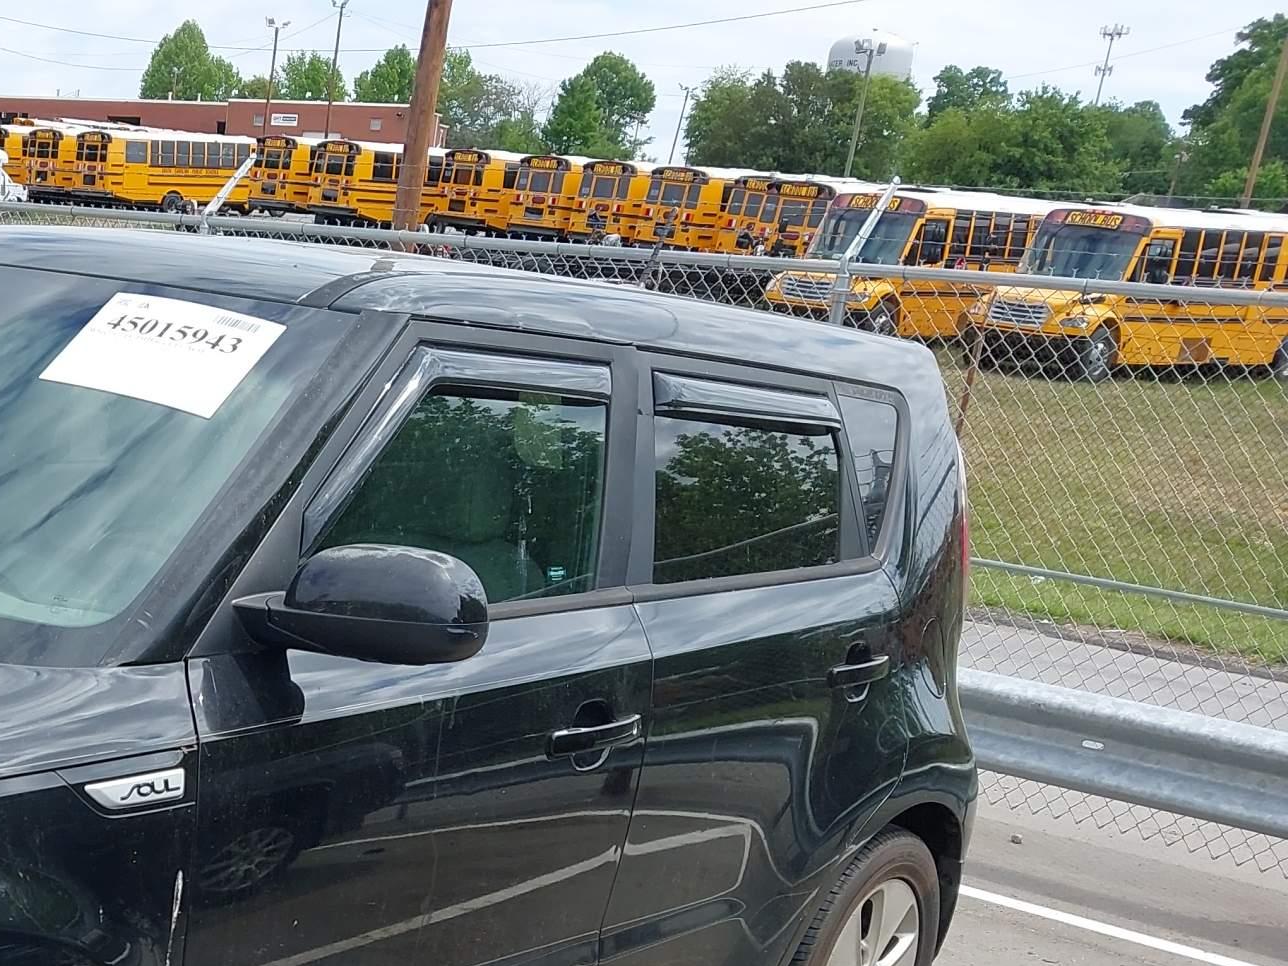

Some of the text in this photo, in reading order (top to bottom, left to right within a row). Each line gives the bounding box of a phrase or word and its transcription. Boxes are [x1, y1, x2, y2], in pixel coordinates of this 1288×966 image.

[1070, 212, 1120, 228] SCHOOL BUS
[106, 314, 243, 354] 45015943
